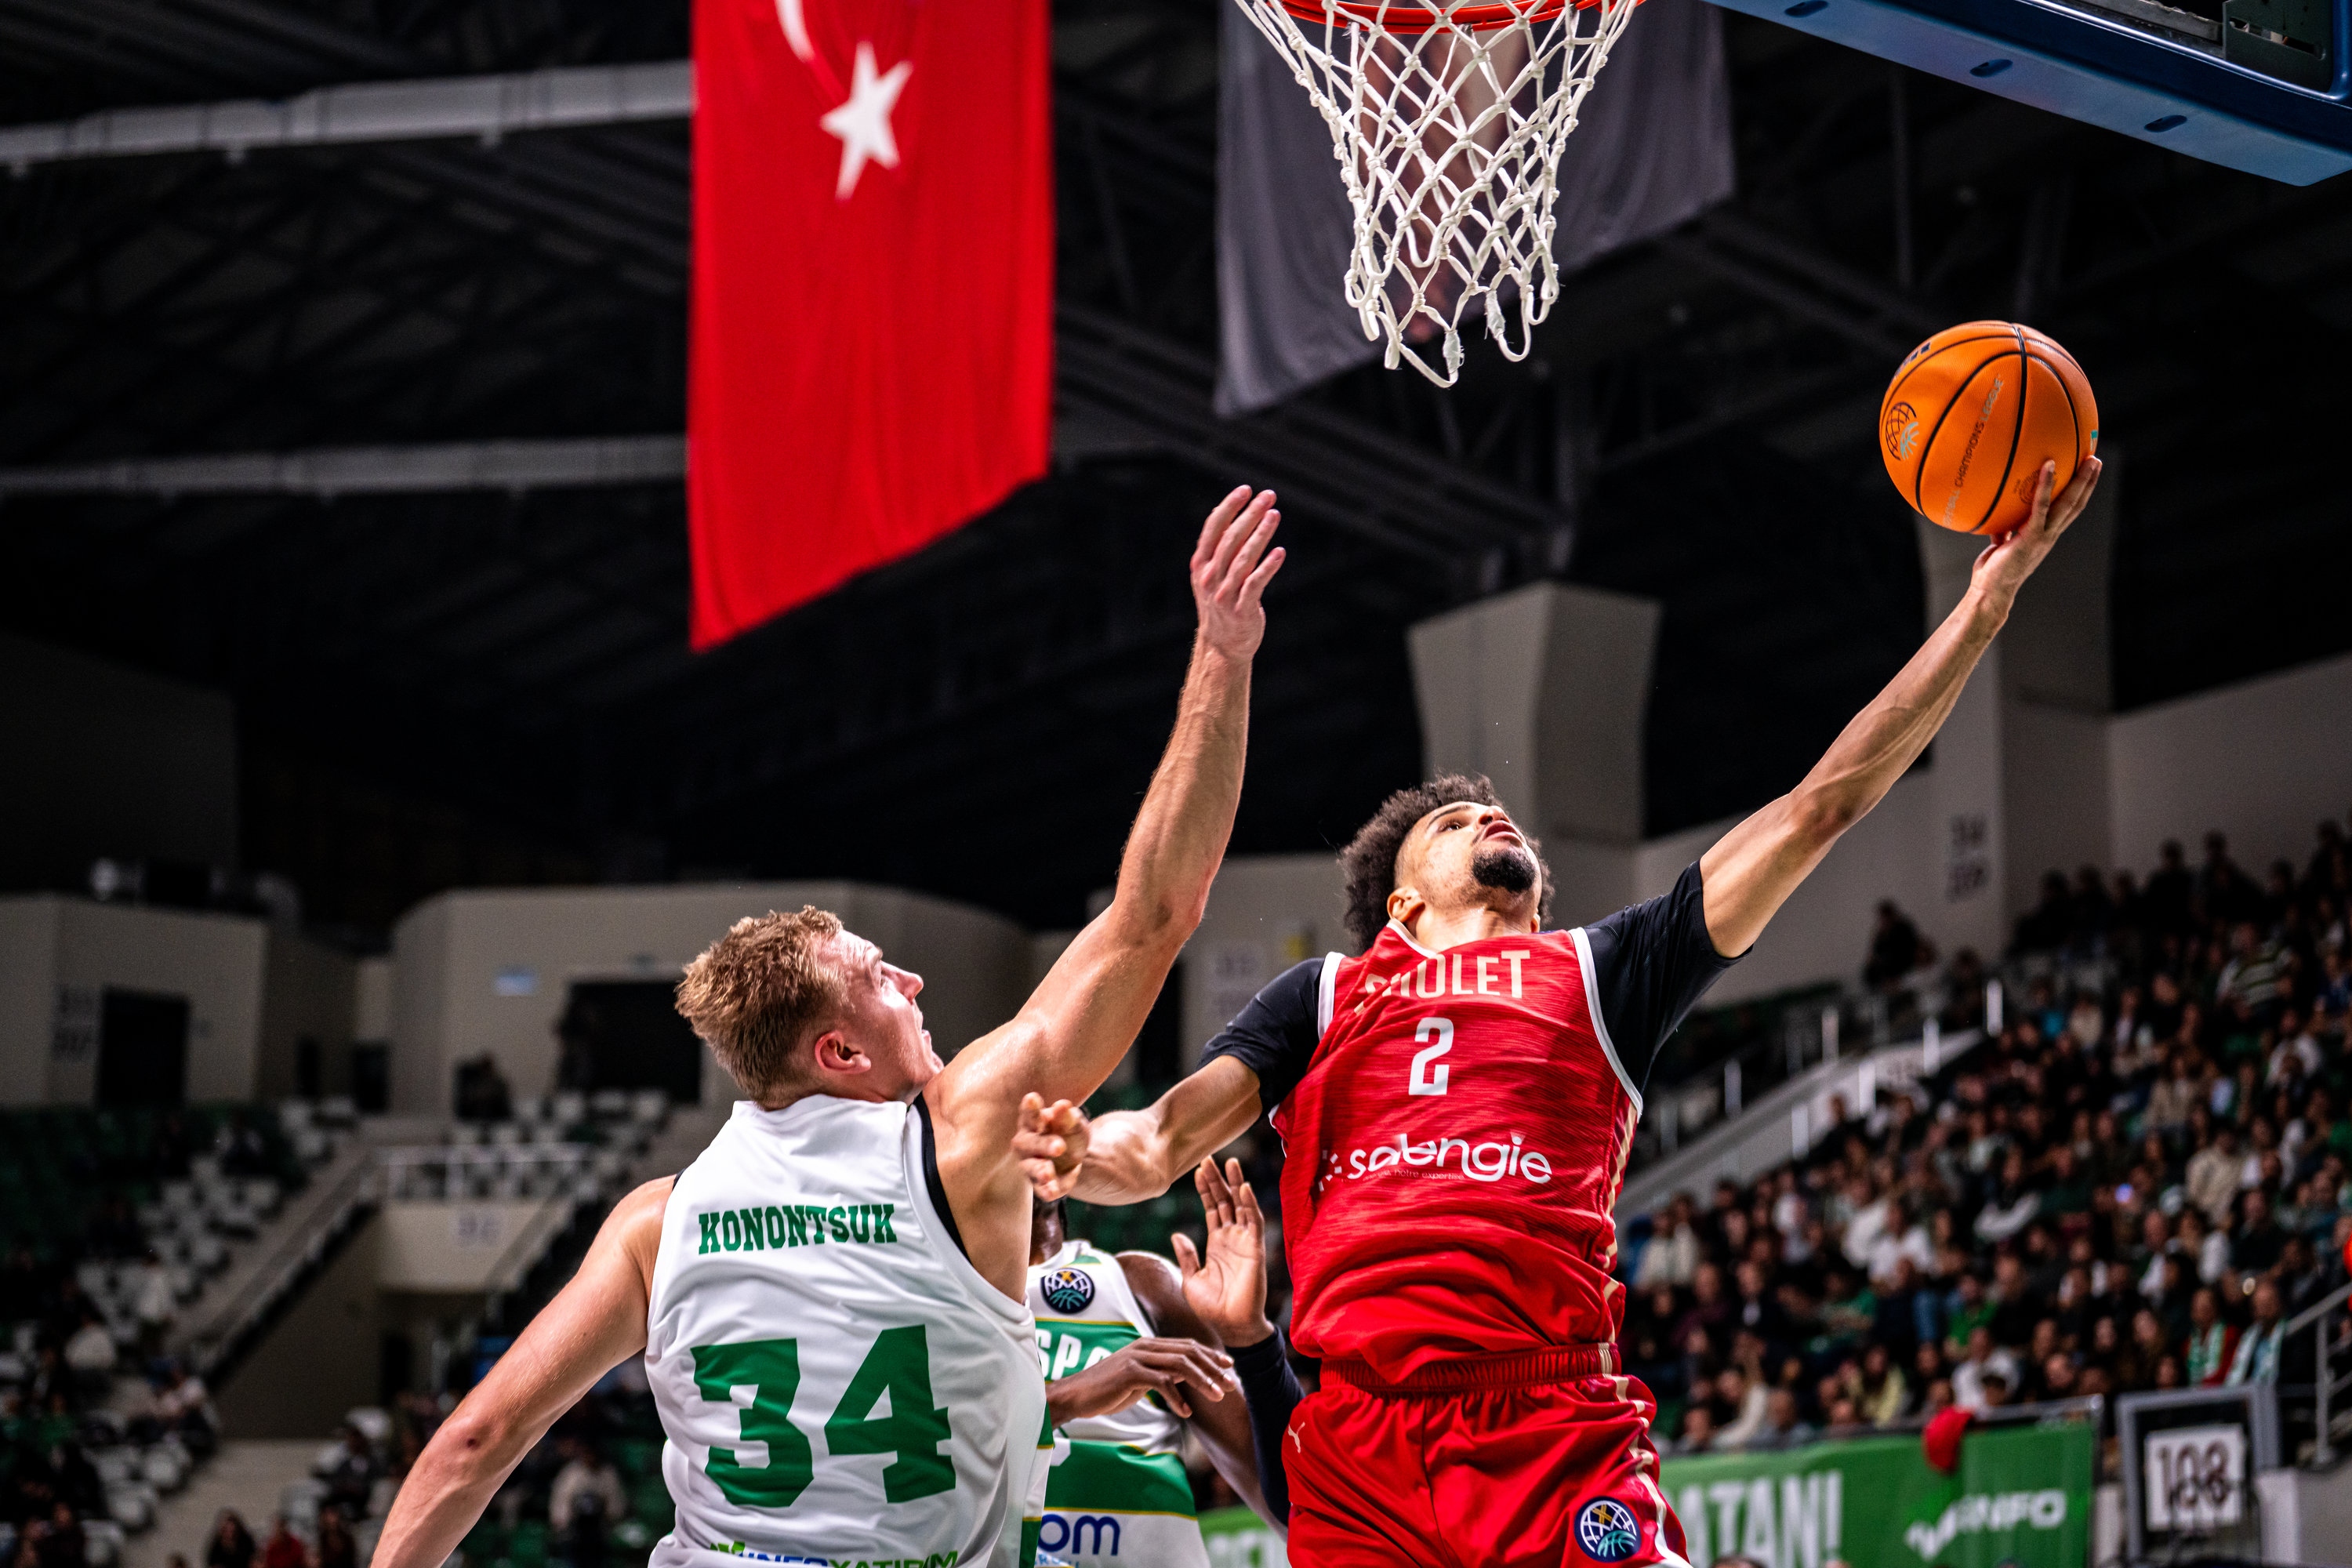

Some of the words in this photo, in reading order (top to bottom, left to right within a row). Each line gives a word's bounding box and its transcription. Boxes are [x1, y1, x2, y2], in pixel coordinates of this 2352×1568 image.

[1955, 421, 1985, 488] CHAMPIONS
[1980, 377, 2004, 422] LEAGUE
[1410, 1017, 1454, 1095] 2
[699, 1203, 897, 1254] KONONTSUK
[690, 1324, 956, 1508] 34
